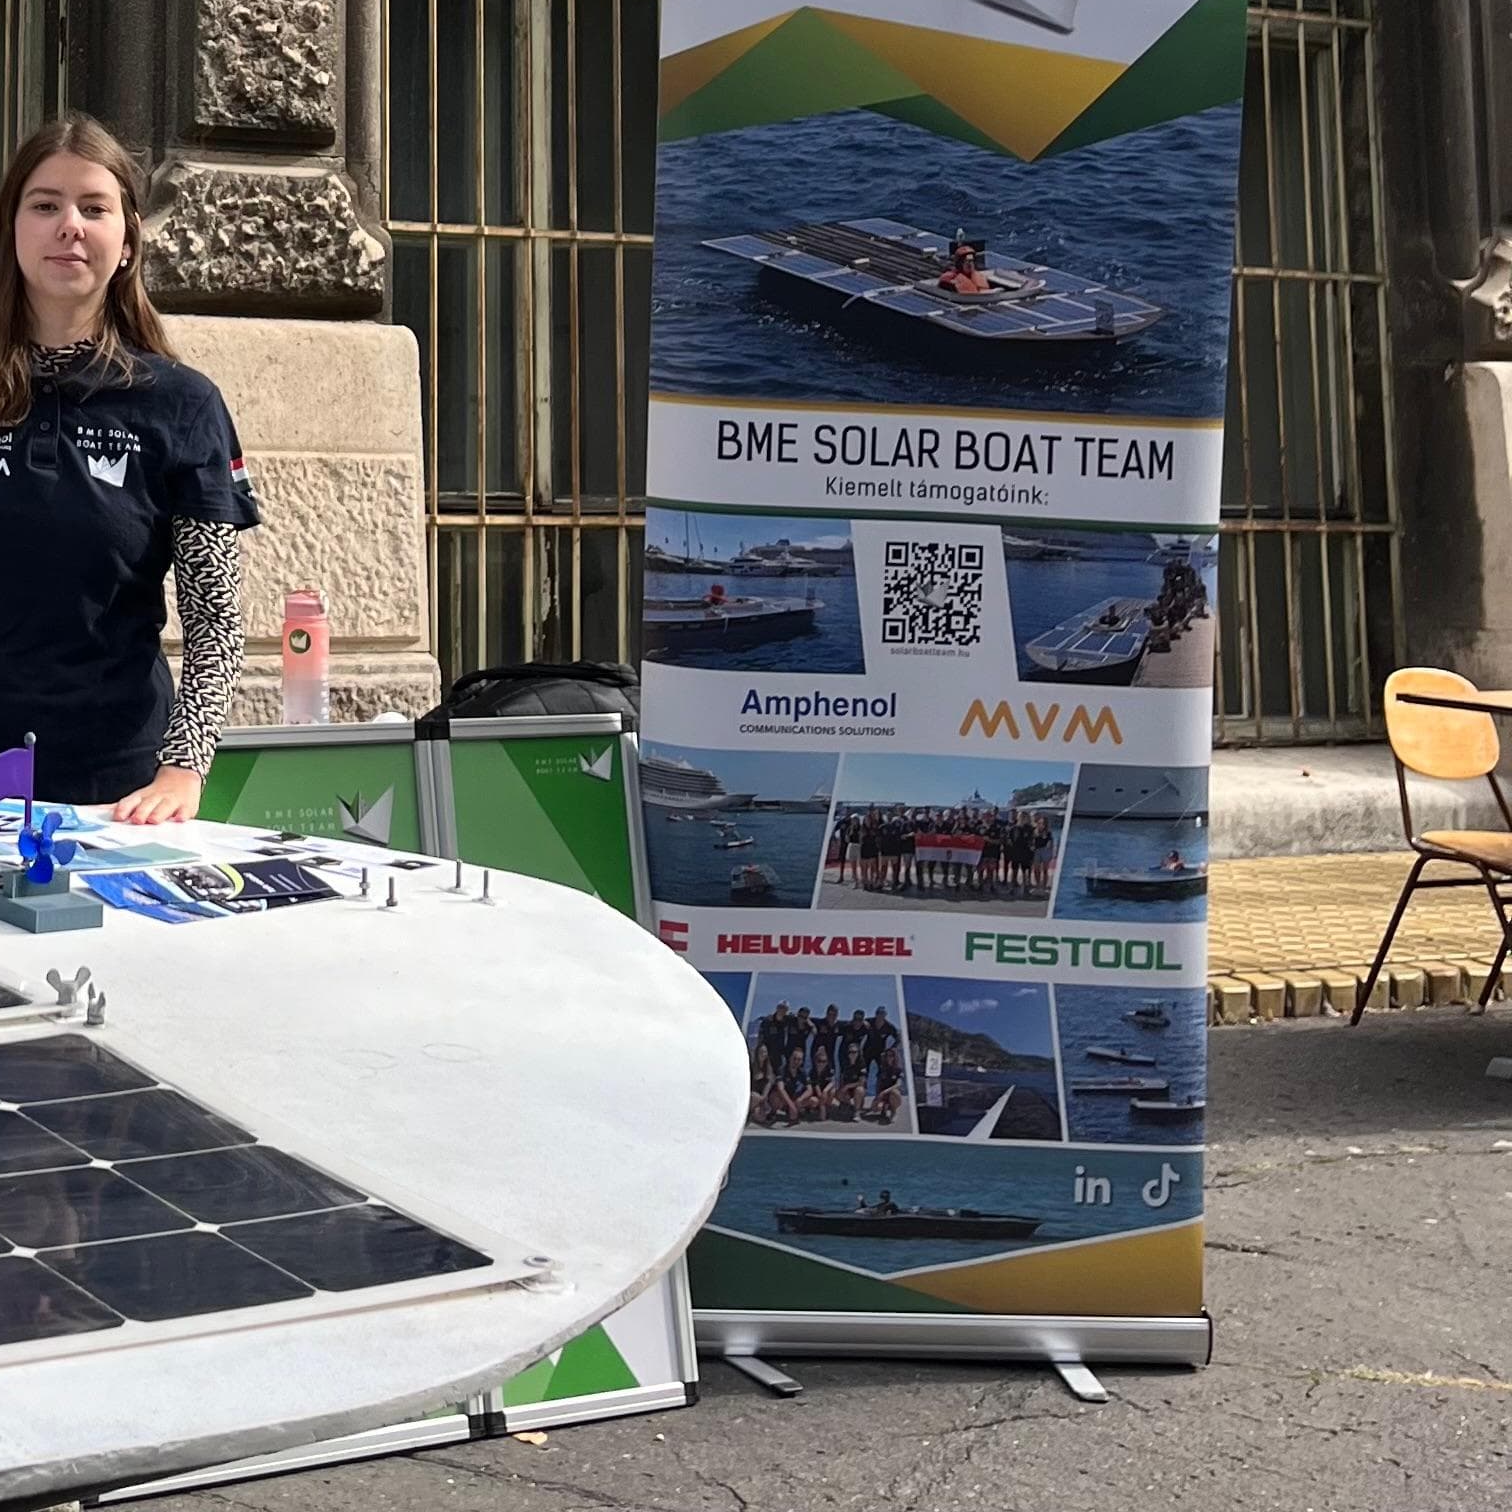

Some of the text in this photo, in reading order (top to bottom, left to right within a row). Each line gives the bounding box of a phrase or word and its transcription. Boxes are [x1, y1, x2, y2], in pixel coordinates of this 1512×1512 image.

[76, 439, 142, 453] BOAT TEAM
[717, 420, 1174, 481] BME SOLAR BOAT TEAM
[825, 476, 1050, 506] Kiemelt támogatóink:
[740, 689, 897, 723] Amphenol
[959, 699, 1123, 745] MVM
[739, 724, 896, 737] COMMUNICATIONS SOLUTIONS
[717, 934, 913, 957] HELUKABEL
[965, 931, 1183, 971] FESTOOL
